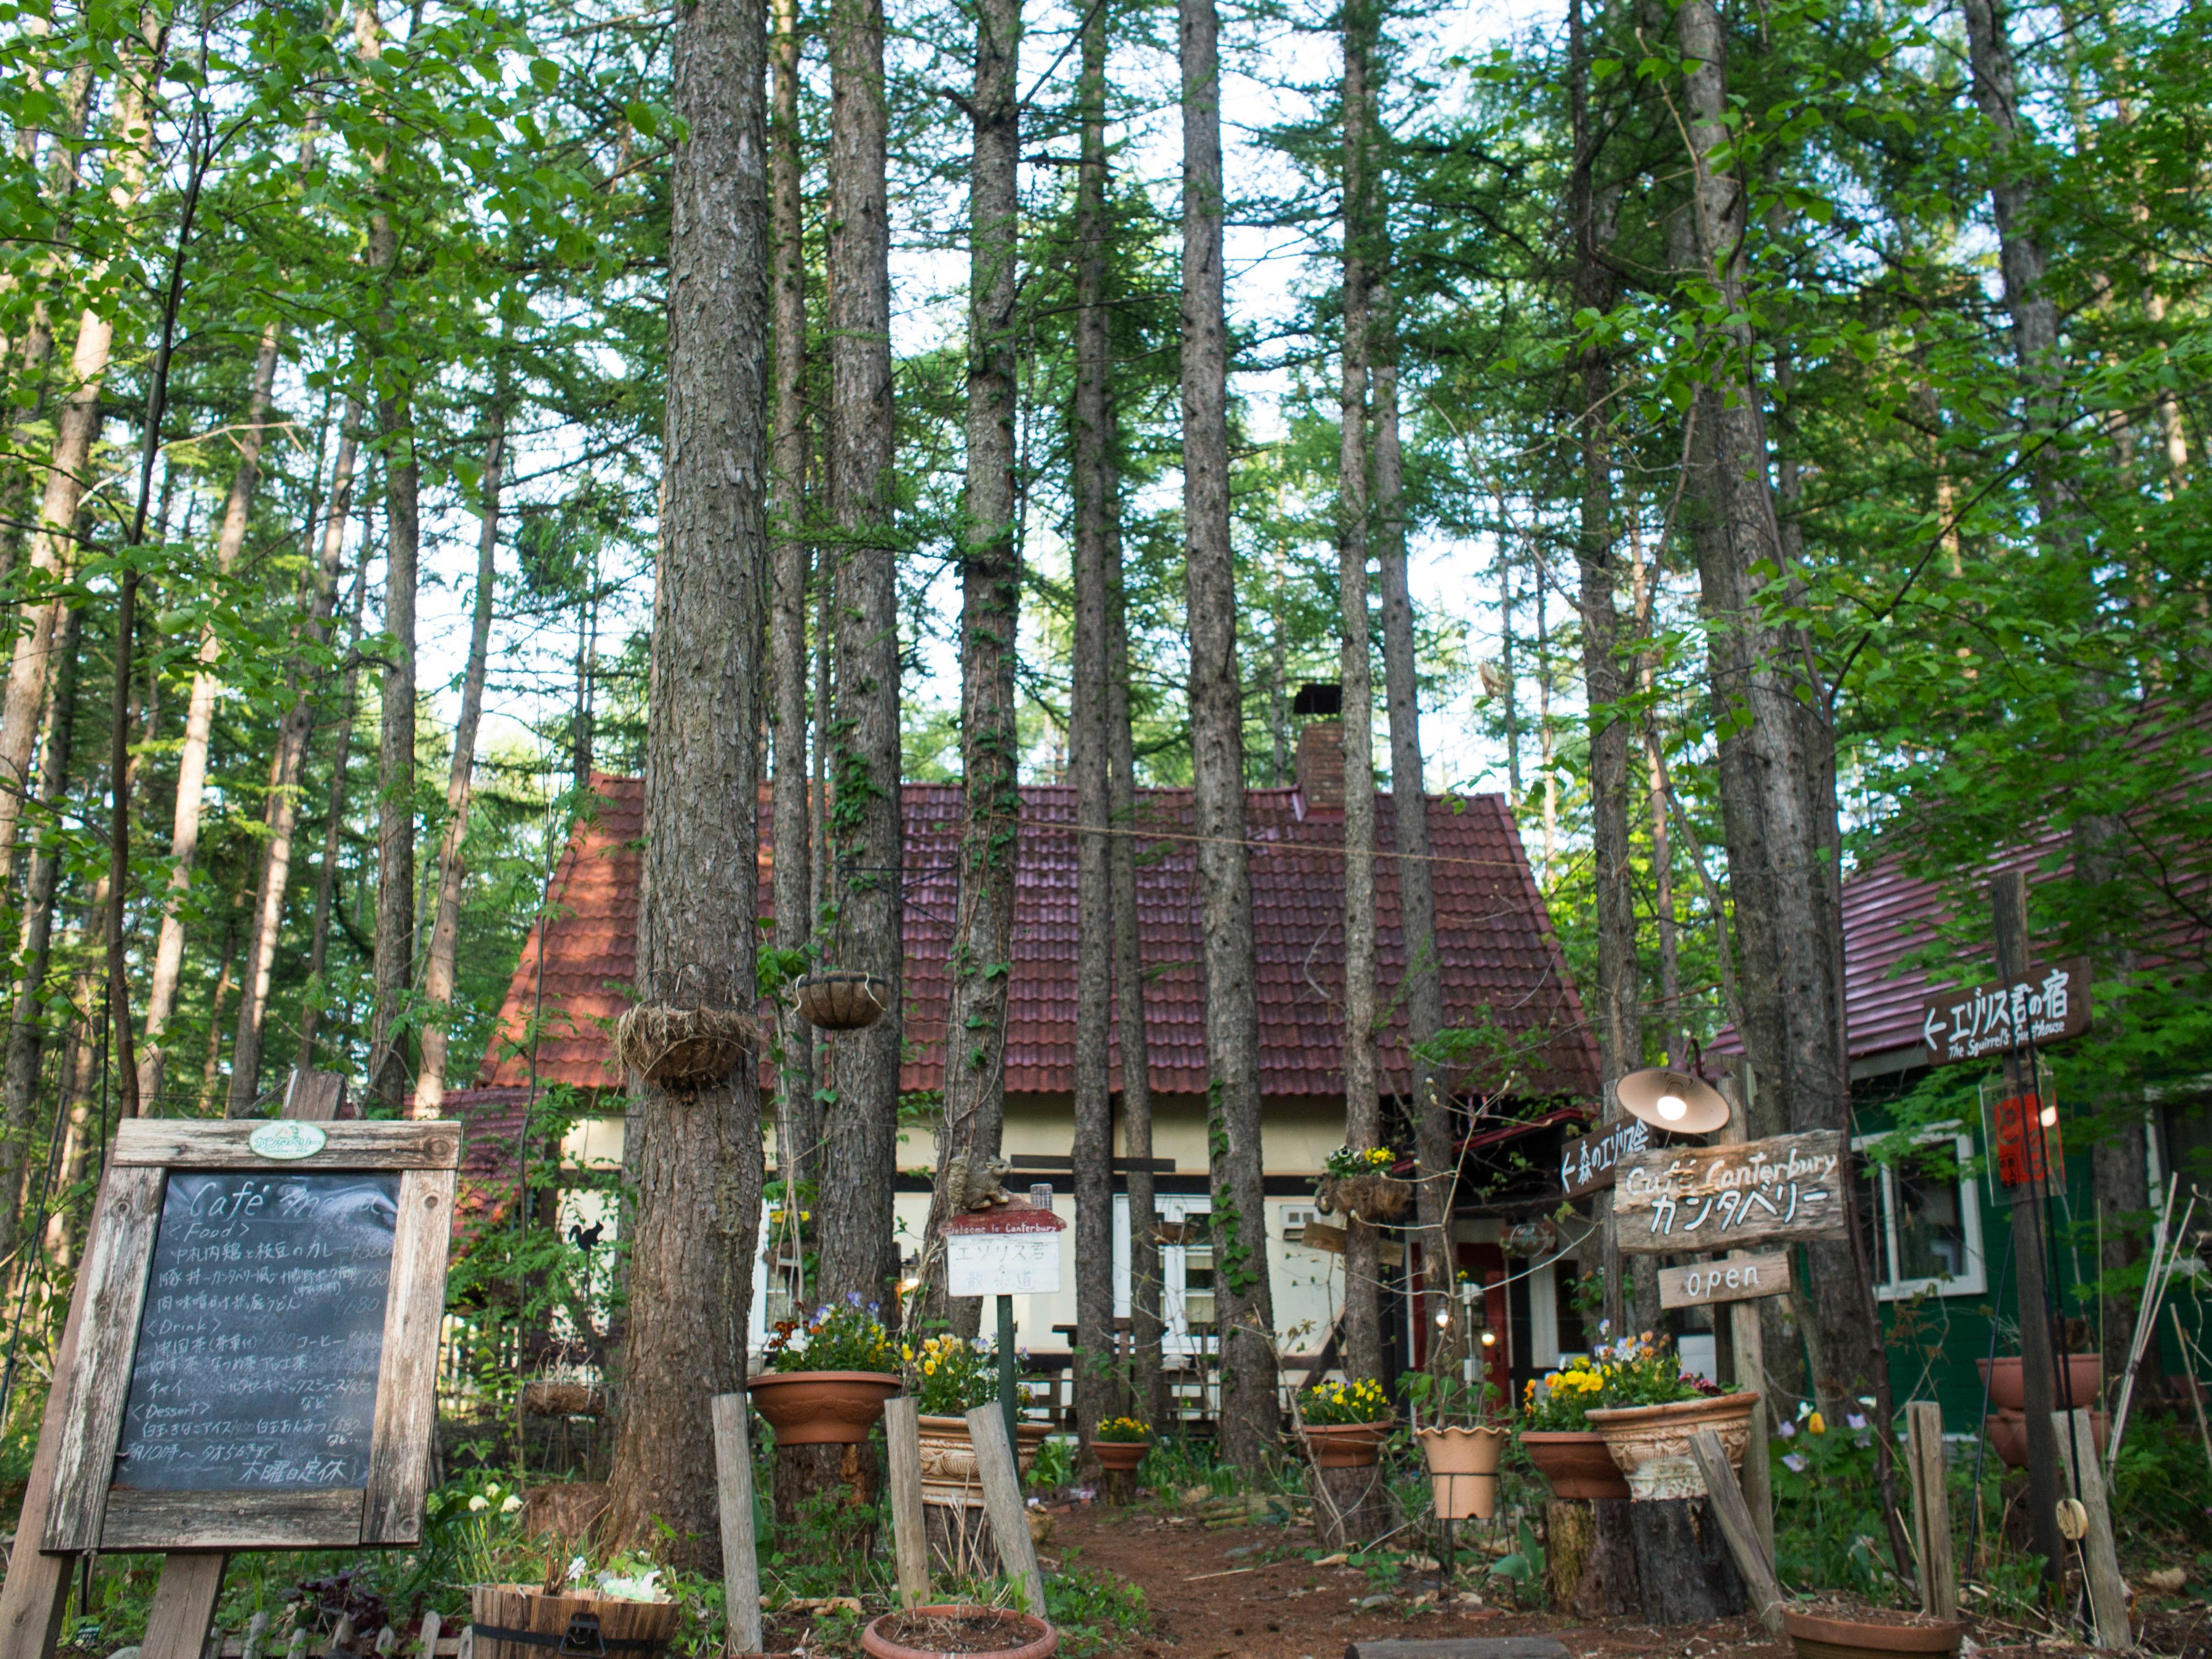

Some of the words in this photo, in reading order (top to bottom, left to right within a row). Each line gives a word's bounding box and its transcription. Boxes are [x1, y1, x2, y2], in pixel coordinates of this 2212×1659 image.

[1948, 968, 2069, 1043] エゾリス君の宿
[1948, 1043, 1964, 1060] The
[1967, 1028, 2010, 1057] Squirrel's
[254, 1137, 321, 1148] カンタベリー
[1625, 1158, 1697, 1196] Café
[1705, 1147, 1838, 1191] Canterbury
[190, 1181, 271, 1222] Café
[1649, 1178, 1830, 1236] カンタベリー
[1005, 1222, 1056, 1233] Canterbury
[1687, 1266, 1760, 1298] open
[296, 1335, 346, 1349] コーヒー
[301, 1393, 332, 1411] など
[237, 1455, 347, 1483] 木曜日定休
